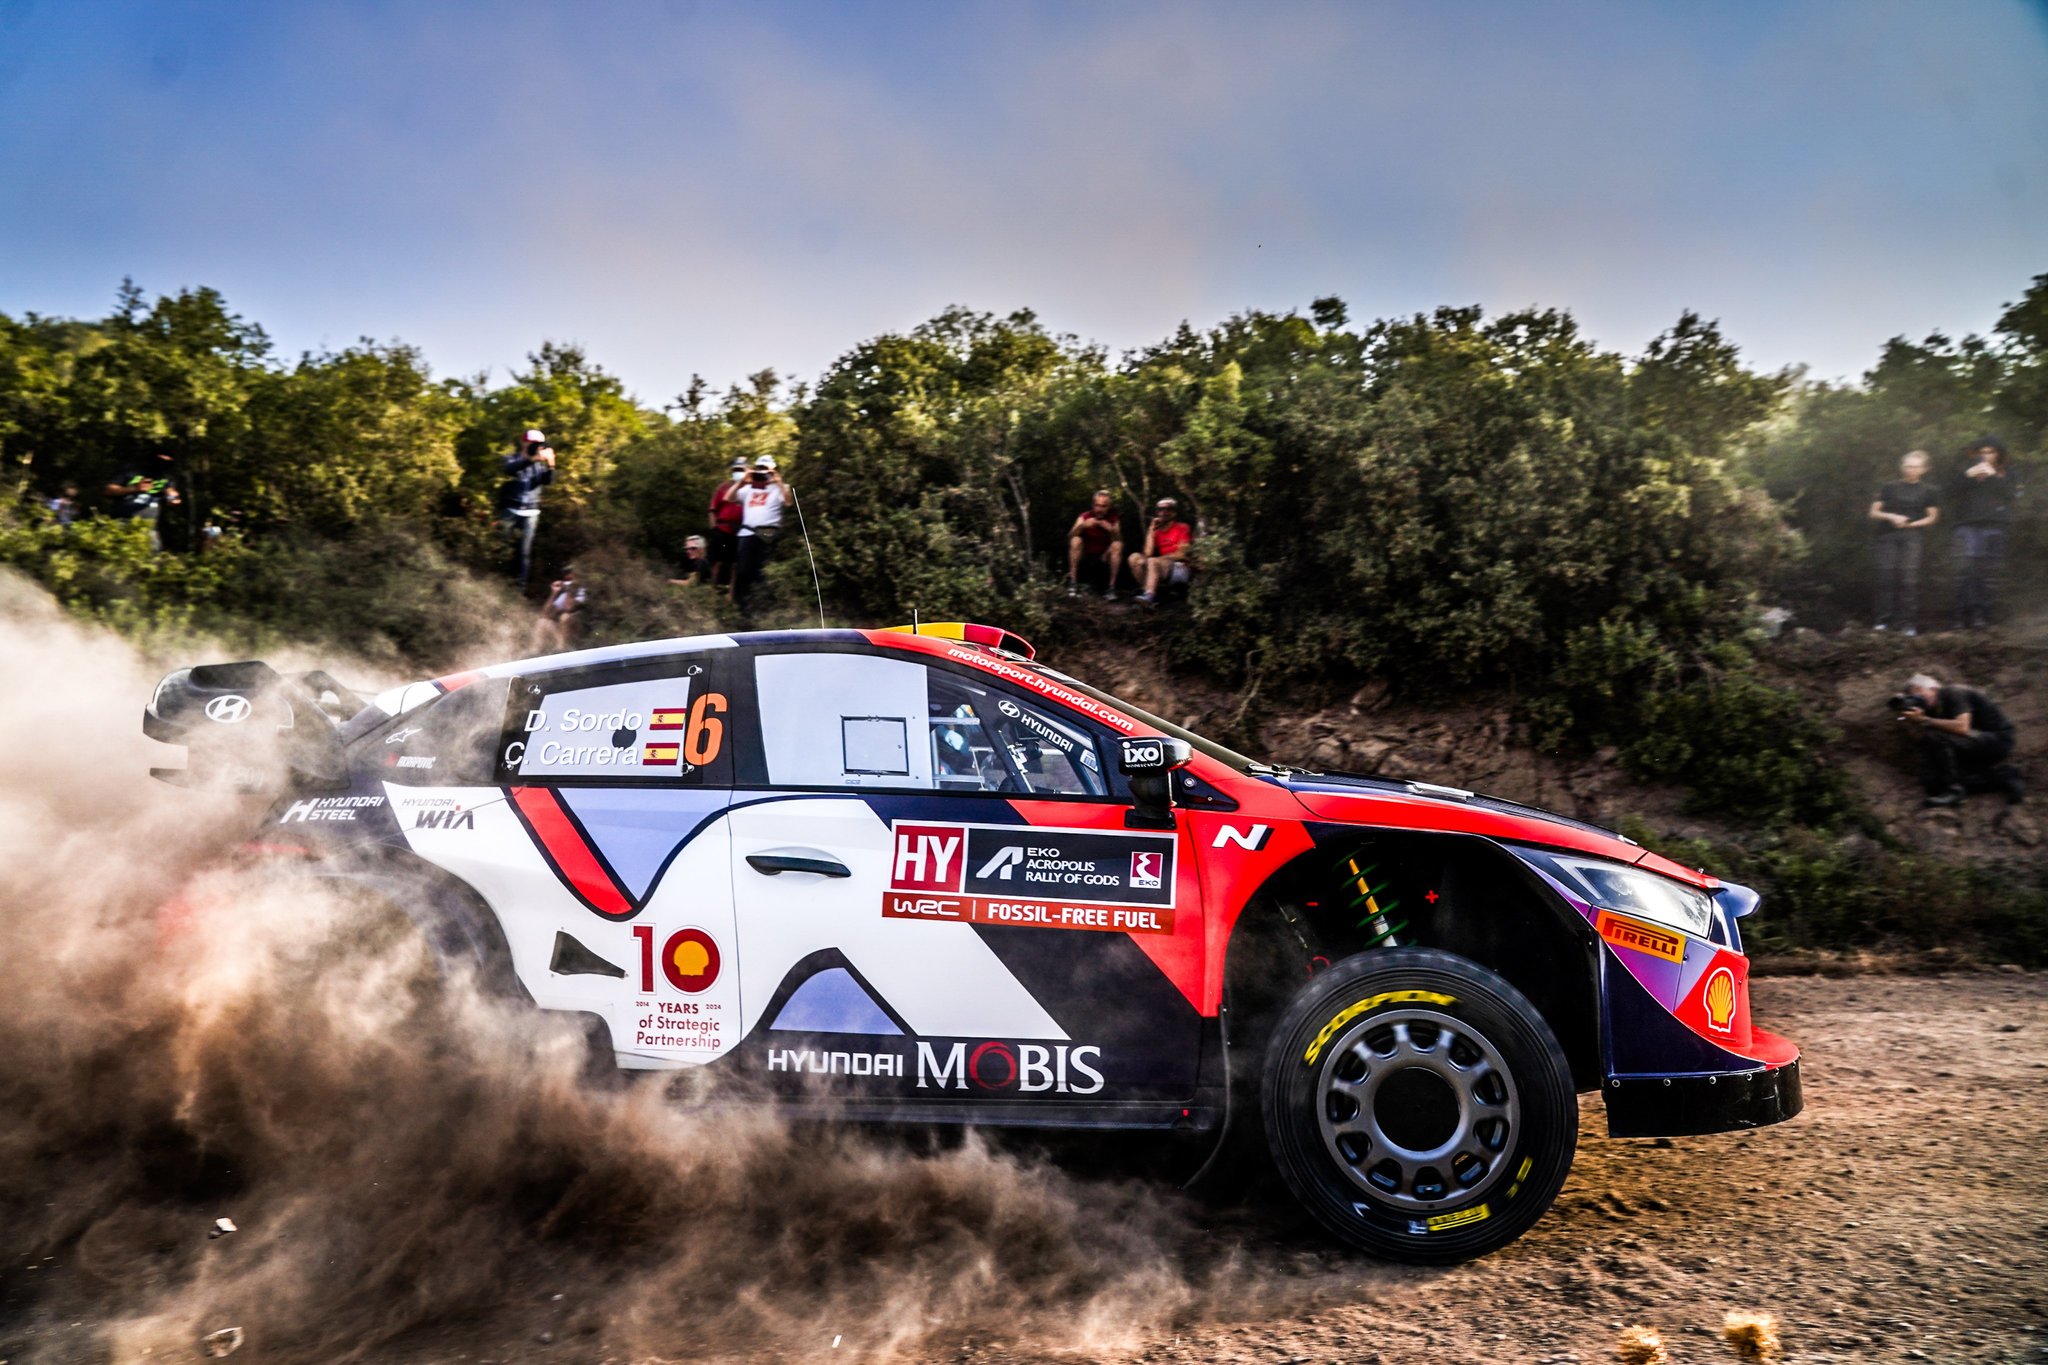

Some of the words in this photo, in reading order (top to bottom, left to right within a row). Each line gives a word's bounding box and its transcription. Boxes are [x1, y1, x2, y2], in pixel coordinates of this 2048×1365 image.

[948, 648, 1134, 732] motorsport.hyundai.com
[524, 709, 551, 732] D.
[560, 708, 644, 733] Sordo
[684, 692, 728, 766] 6
[1020, 714, 1074, 753] HYUNDAI
[505, 741, 529, 766] C.
[539, 741, 638, 766] Carrera
[317, 796, 385, 808] HYUNDAI
[402, 798, 456, 807] HYUNDAI
[309, 809, 356, 821] STEEL
[895, 834, 960, 883] HY
[1027, 847, 1060, 858] EKO
[1026, 859, 1096, 872] ACROPOLIS
[1025, 871, 1063, 884] RALLY
[1064, 873, 1083, 884] OF
[1083, 874, 1120, 887] GODS
[1138, 879, 1159, 887] EKO
[894, 898, 960, 917] WRC
[988, 903, 1108, 927] FOSSIL-FREE
[1113, 911, 1161, 930] FUEL
[1602, 917, 1679, 957] PIRELLI
[658, 1002, 699, 1014] YEARS
[638, 1014, 653, 1029] of
[657, 1015, 720, 1034] Strategic
[636, 1031, 721, 1050] Partnership
[768, 1049, 904, 1077] HYUNDAI
[915, 1041, 1105, 1094] MOBIS
